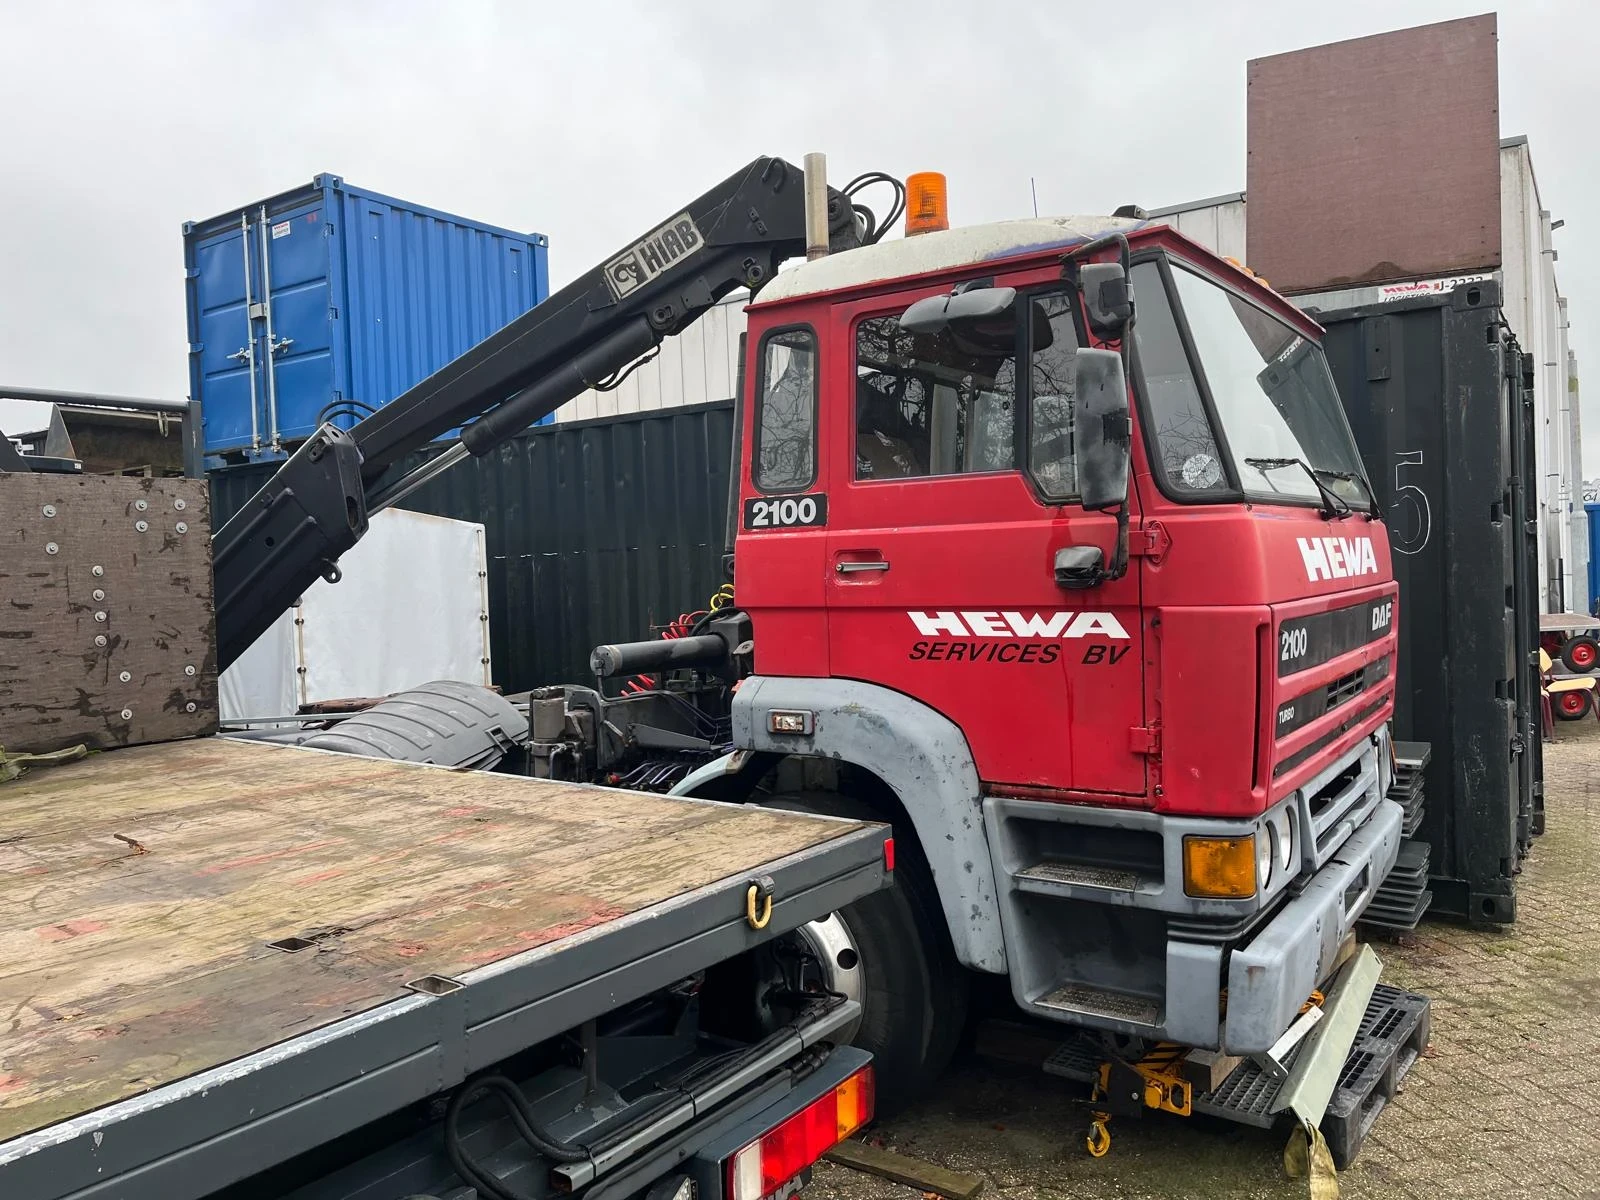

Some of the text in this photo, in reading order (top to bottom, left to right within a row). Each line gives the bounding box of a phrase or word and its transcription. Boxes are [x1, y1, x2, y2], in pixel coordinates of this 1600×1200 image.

[638, 219, 699, 275] HIAB
[752, 497, 817, 526] 2100
[1391, 450, 1430, 554] 5
[1296, 536, 1378, 582] HEWA
[907, 611, 1131, 639] HEWA
[1371, 602, 1392, 632] DAF
[909, 641, 1131, 665] SERVICES BV
[1281, 627, 1307, 661] 2100
